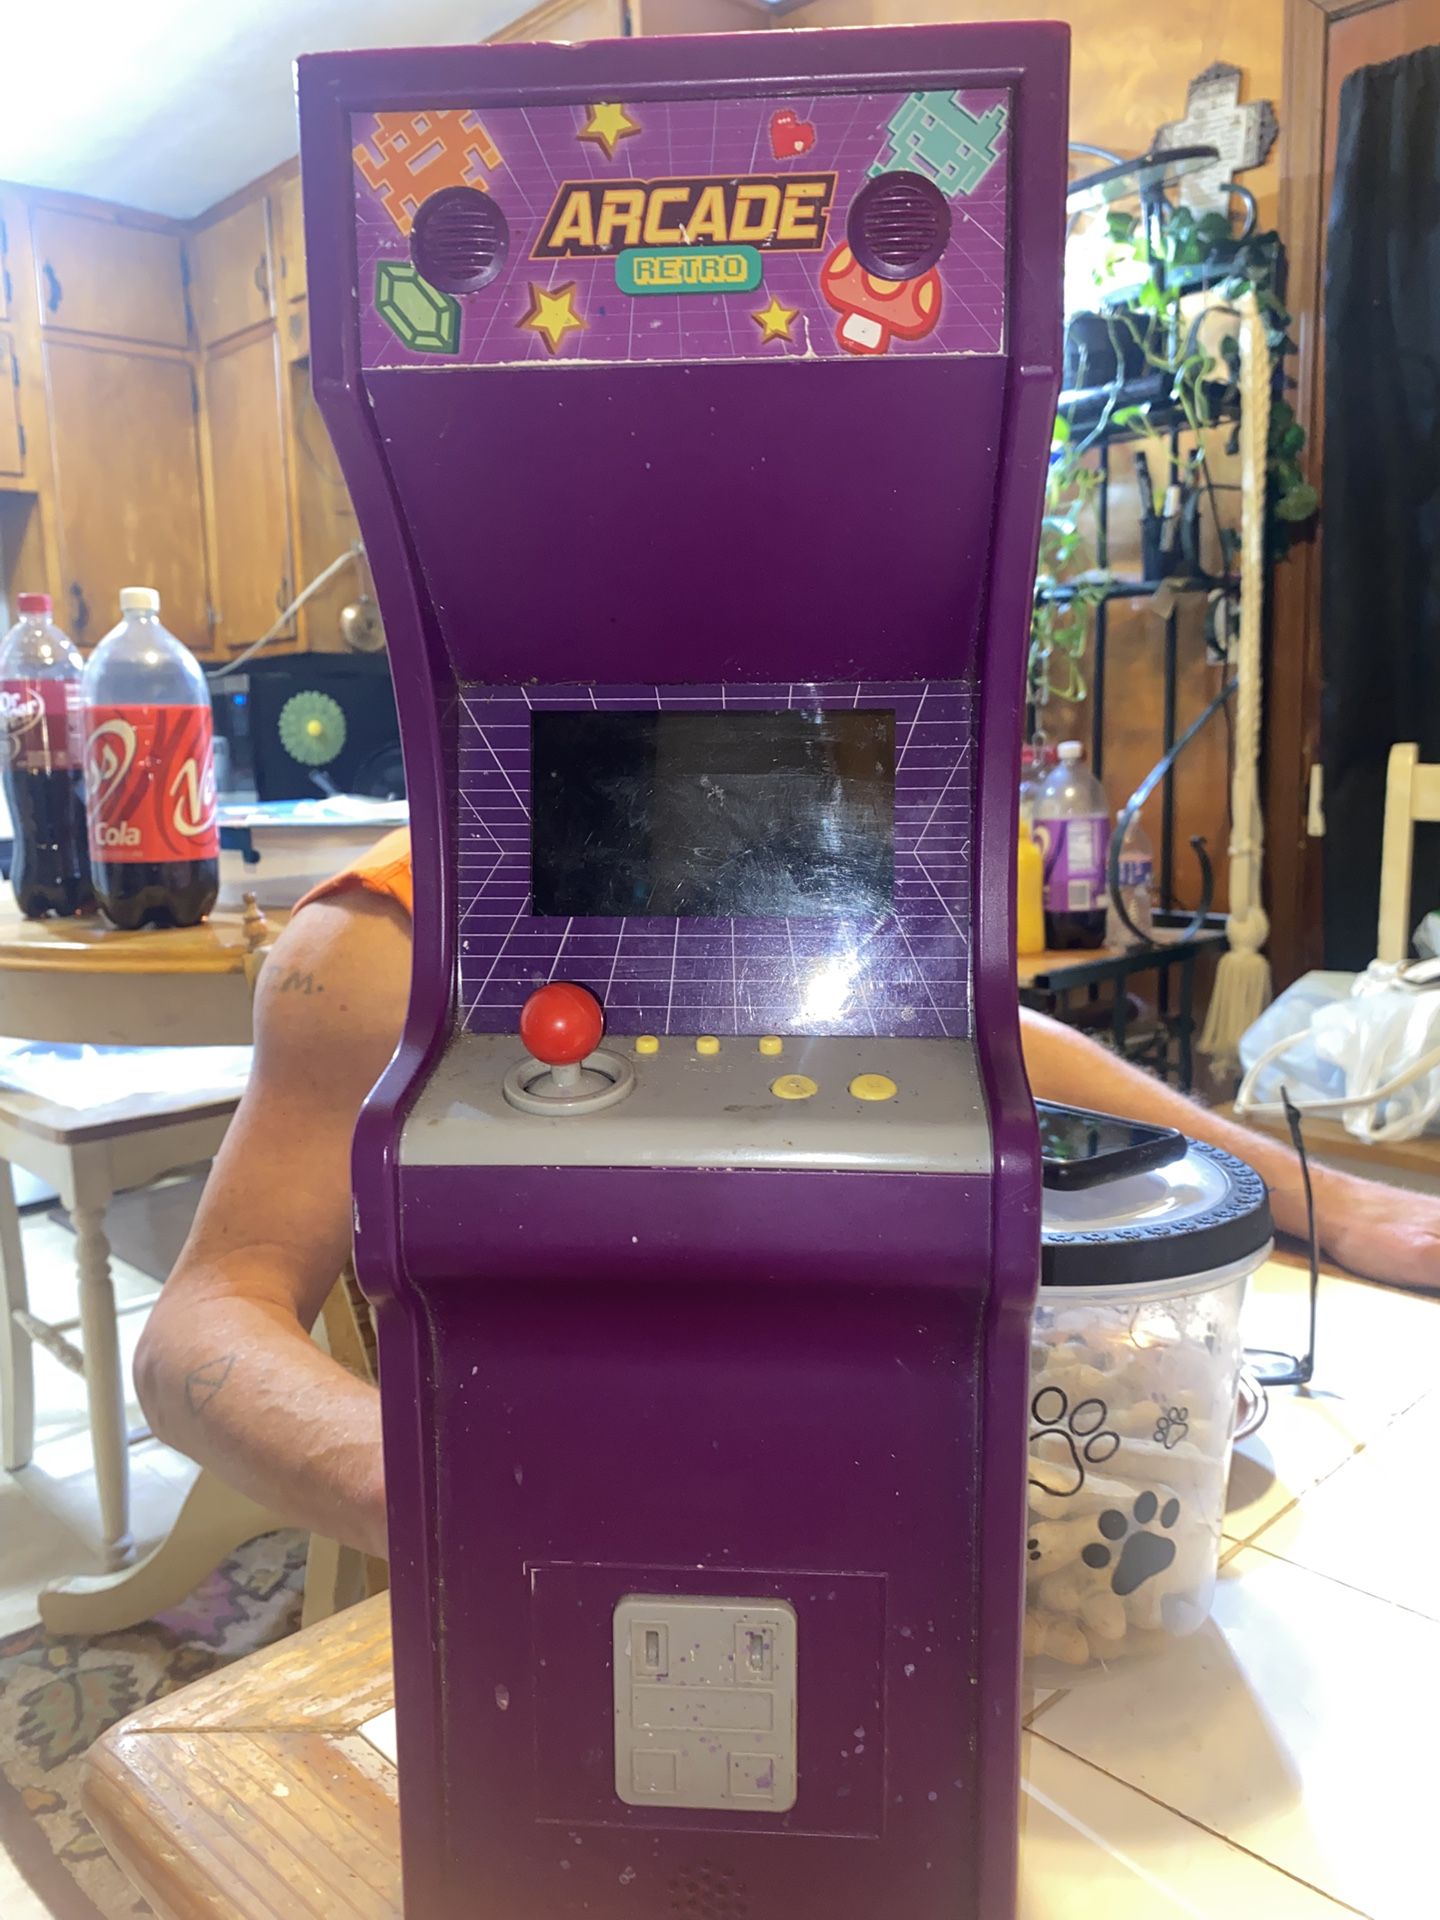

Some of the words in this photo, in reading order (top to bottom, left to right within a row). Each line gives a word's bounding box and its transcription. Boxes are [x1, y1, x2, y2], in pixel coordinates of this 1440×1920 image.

[547, 182, 827, 247] ARCADE
[634, 255, 747, 284] RETRO
[95, 821, 141, 845] Cola
